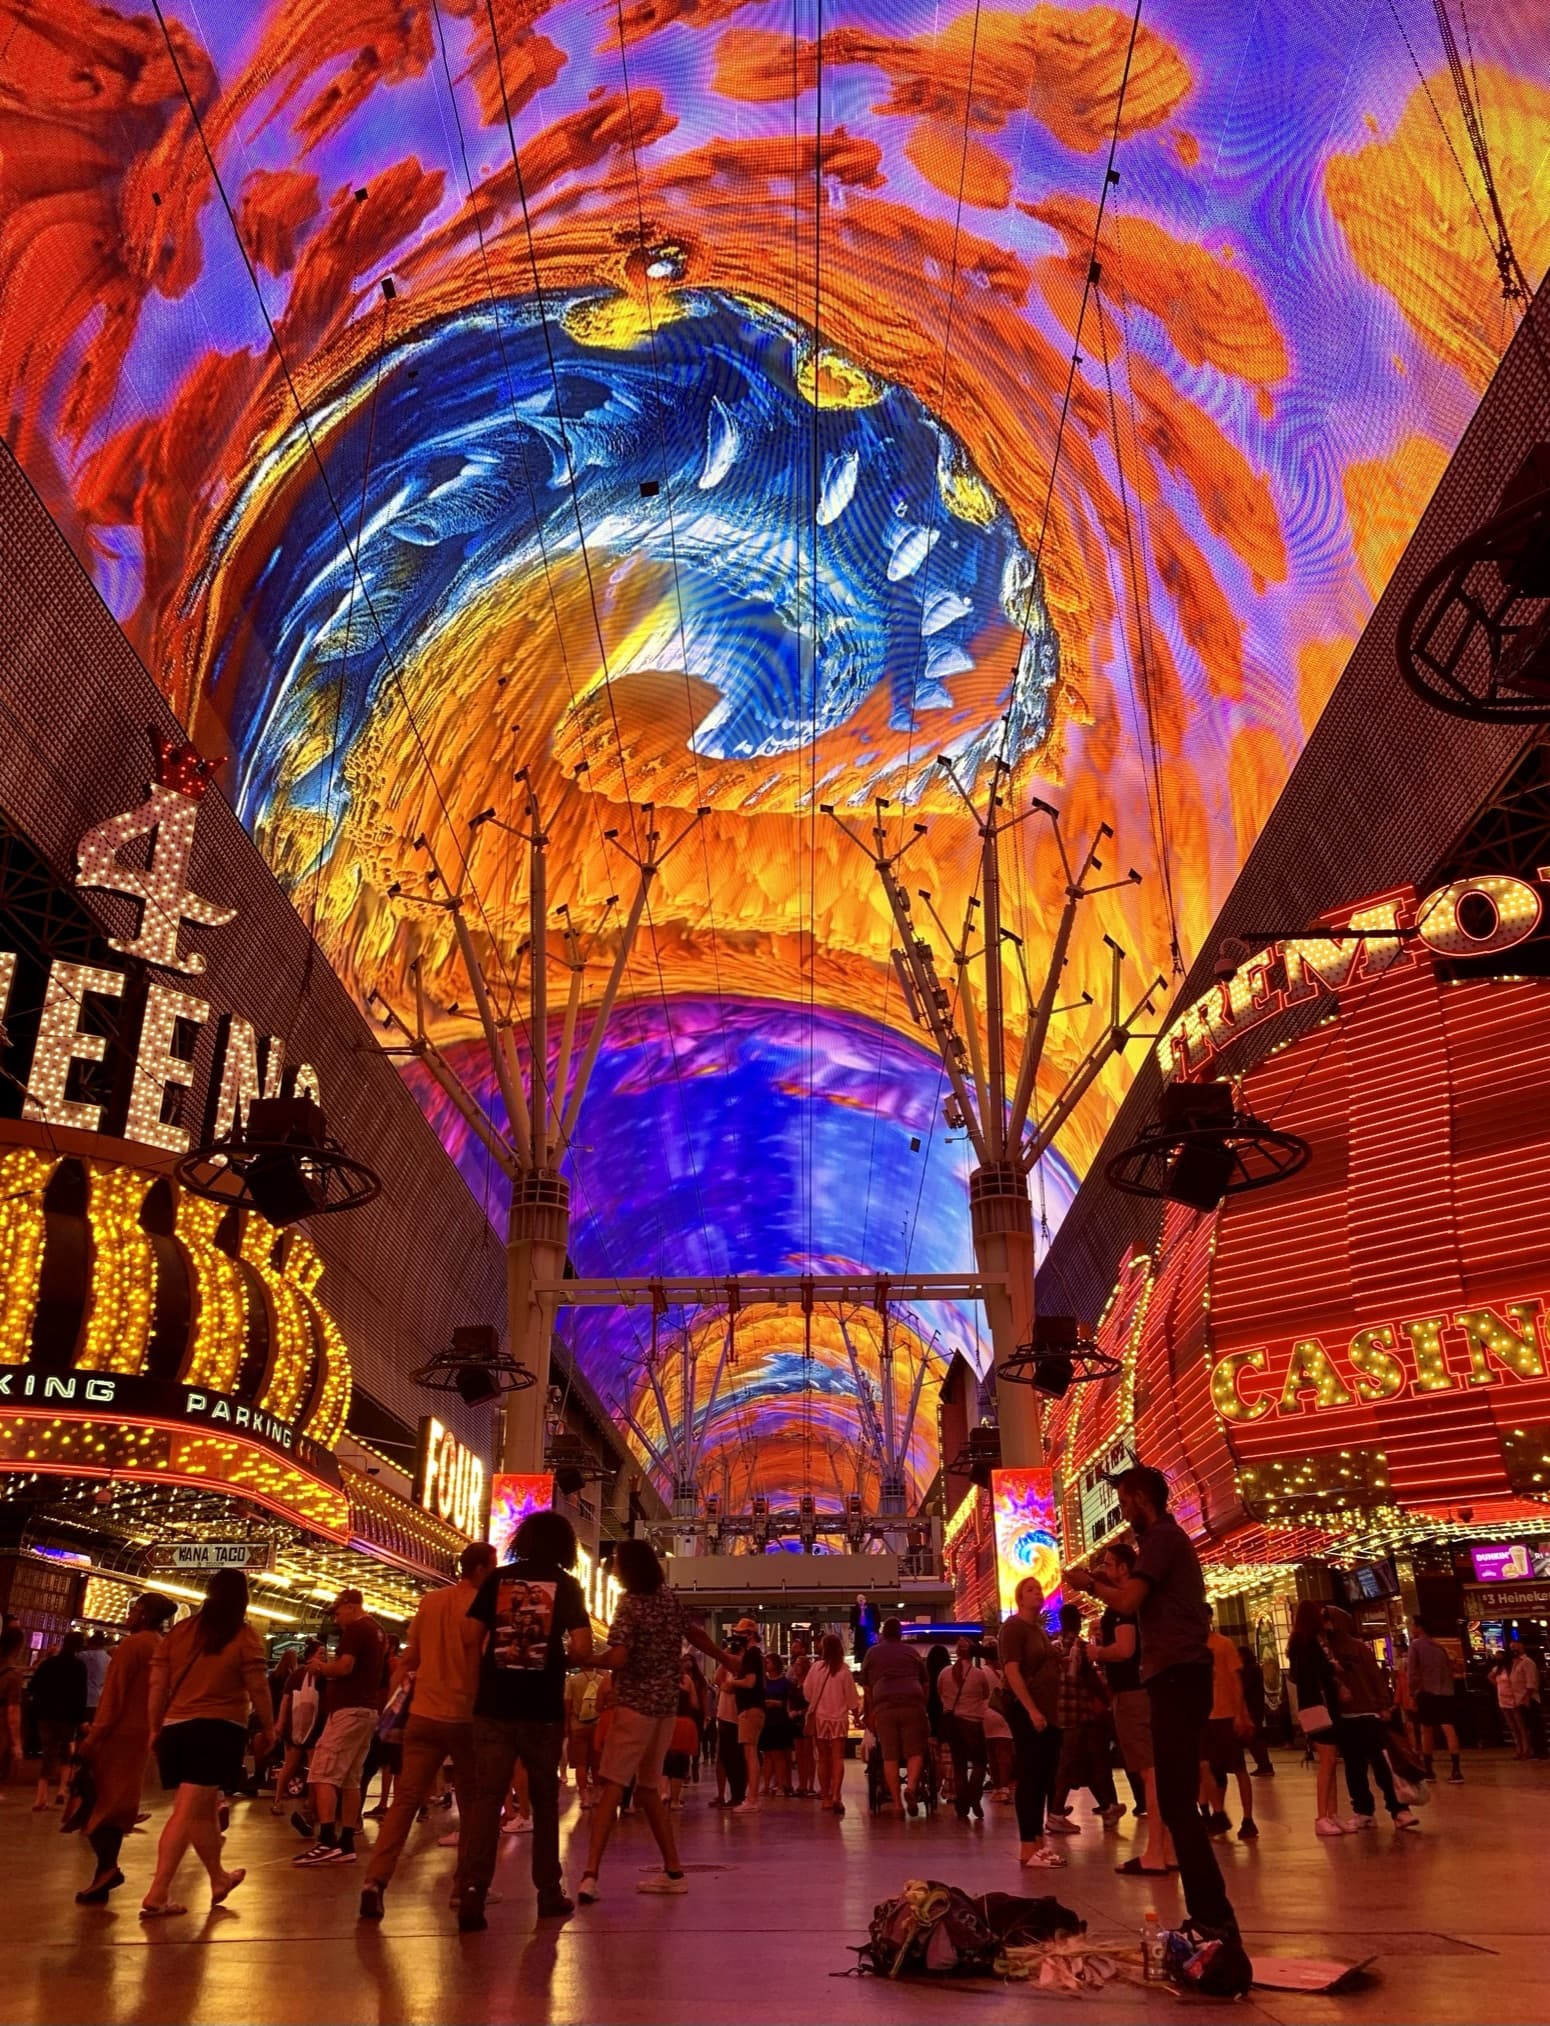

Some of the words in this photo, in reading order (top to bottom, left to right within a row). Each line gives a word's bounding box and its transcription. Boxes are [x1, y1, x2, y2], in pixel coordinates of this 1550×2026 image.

[76, 783, 238, 975] 4
[1155, 866, 1550, 1096] FREMO
[186, 1393, 292, 1448] PARKING
[1210, 1297, 1550, 1424] CASIN
[422, 1416, 484, 1541] FOUR
[214, 1546, 246, 1562] TACO
[1497, 1591, 1550, 1604] Heineke
